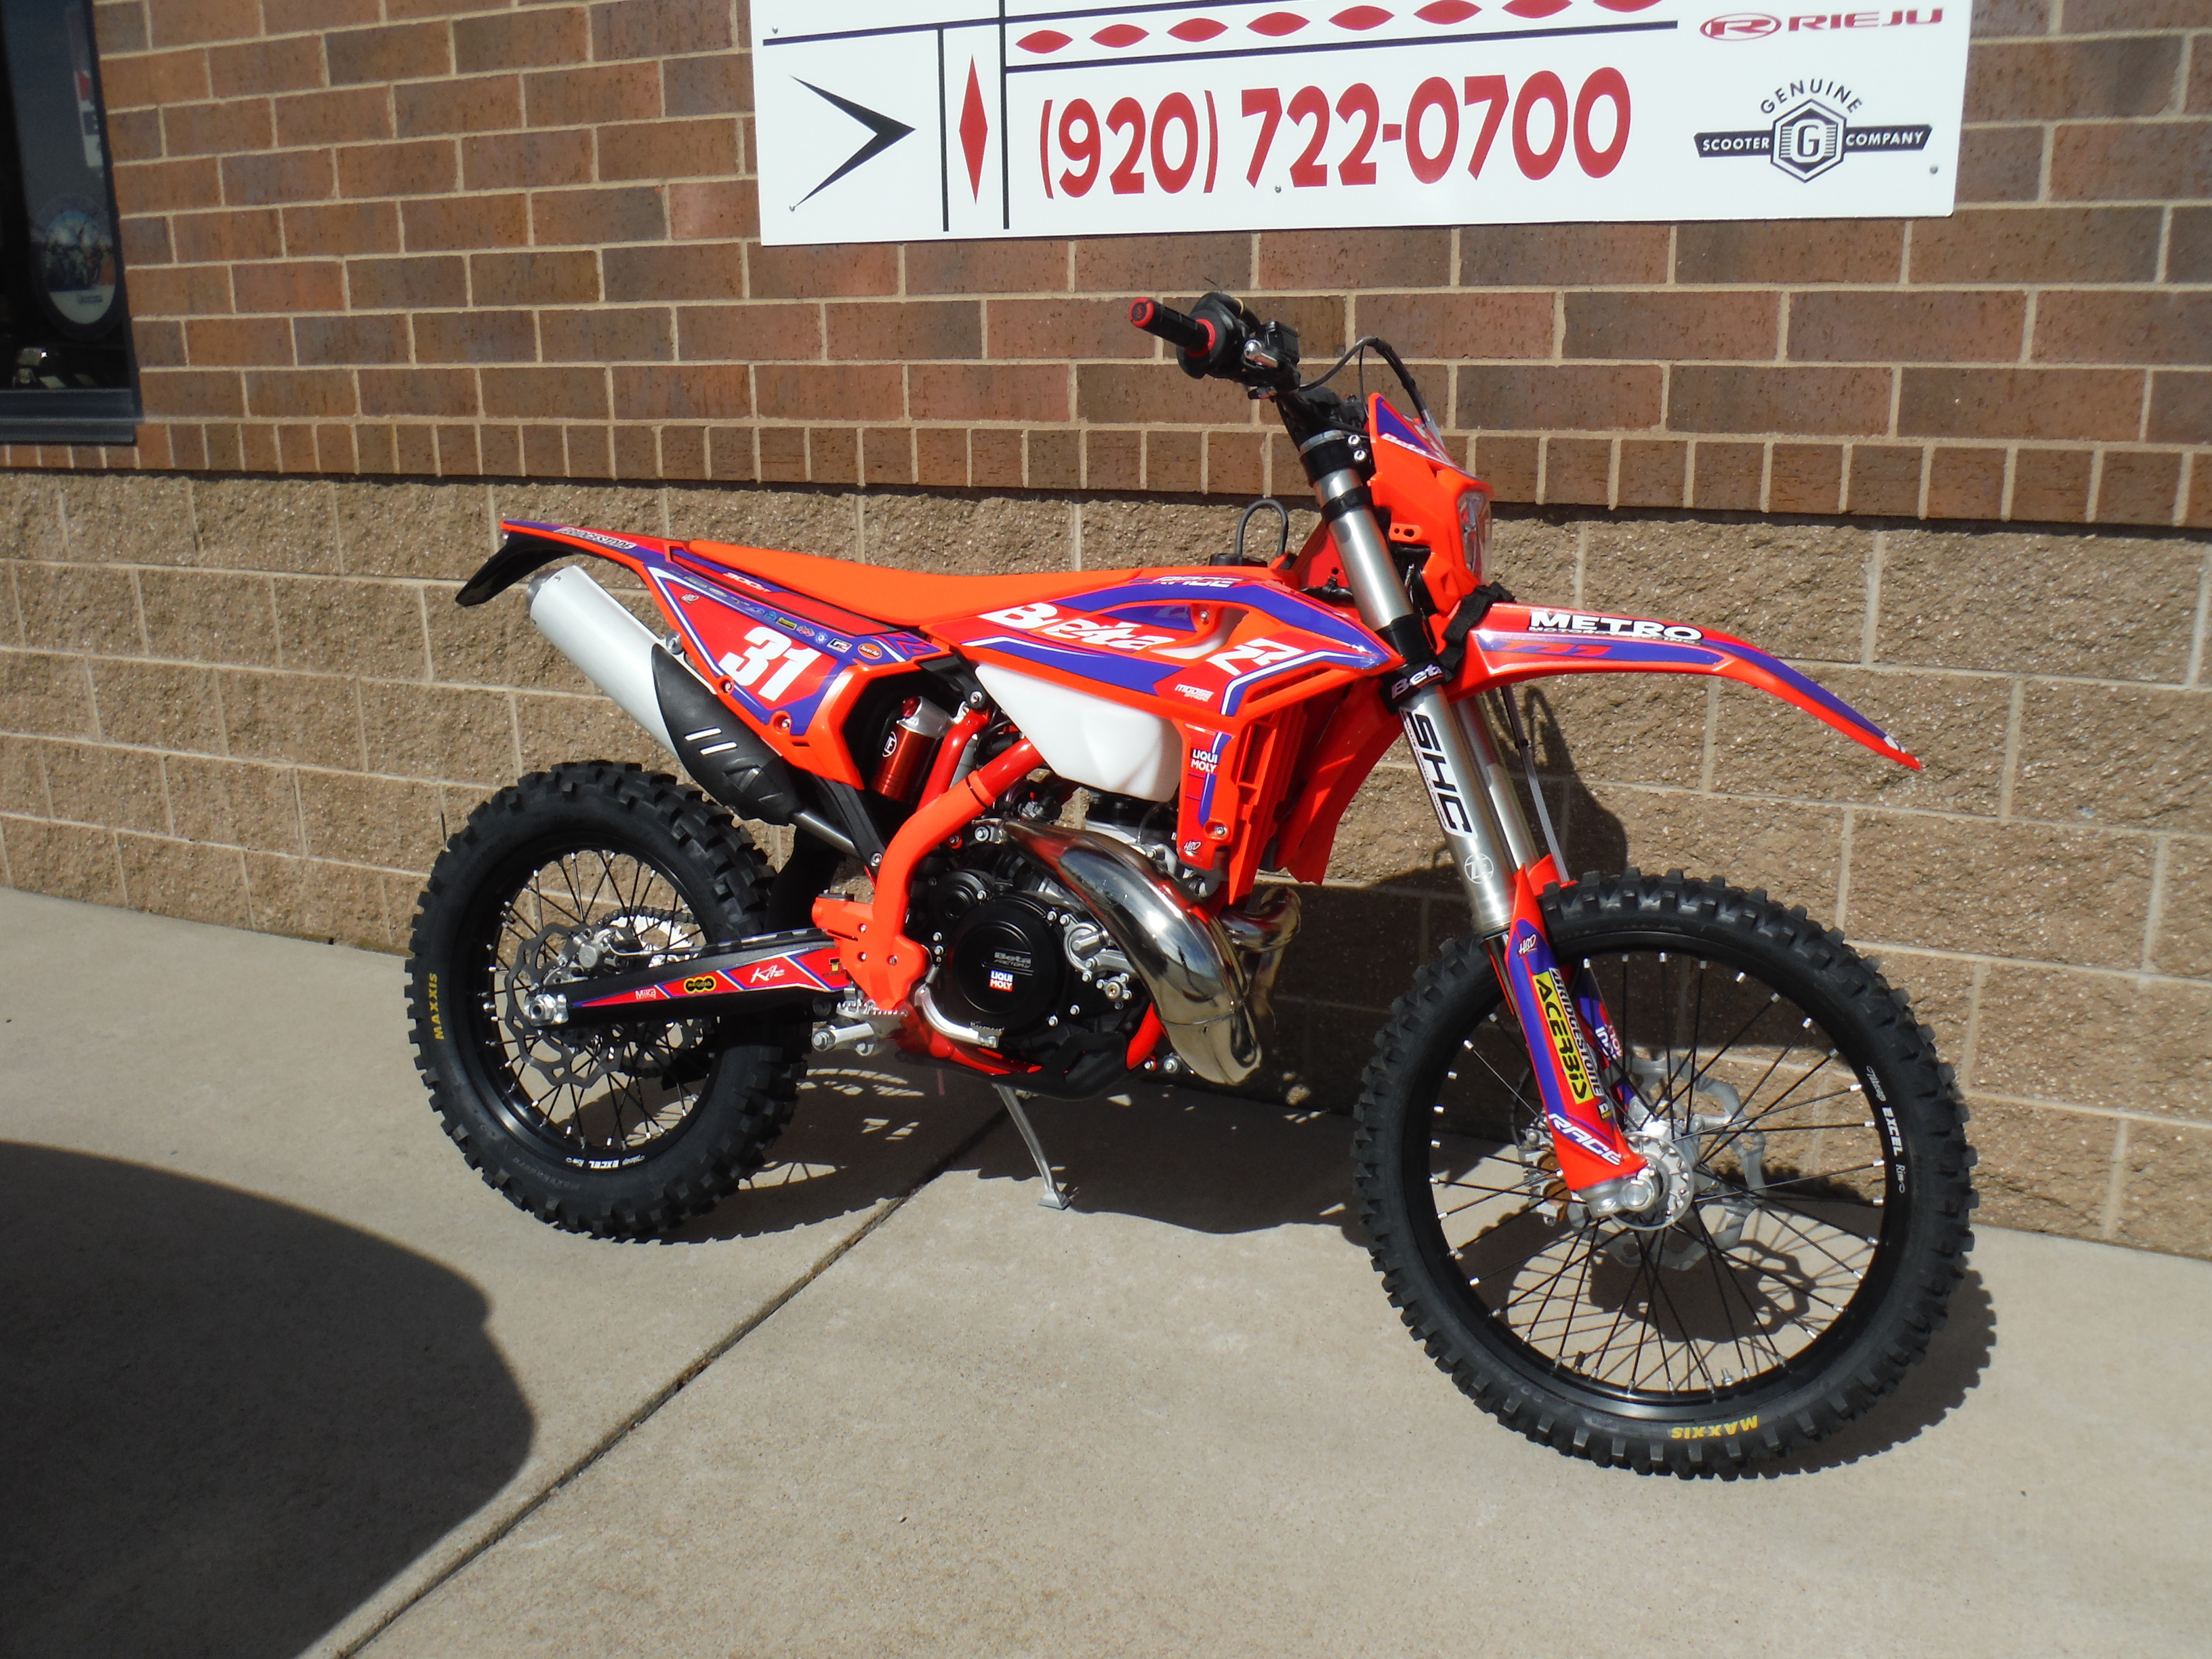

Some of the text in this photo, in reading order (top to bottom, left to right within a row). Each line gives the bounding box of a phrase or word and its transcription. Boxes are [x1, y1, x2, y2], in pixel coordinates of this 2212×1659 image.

[1788, 8, 1943, 31] RIEJU
[1760, 78, 1864, 115] GENUINE
[1040, 66, 1631, 199] (920) 722-0700
[1702, 124, 1925, 157] SCOOTER G COMPANY
[977, 602, 1176, 651] Beta
[1530, 610, 1702, 640] METRO
[859, 645, 872, 653] Twin
[718, 626, 822, 701] 31
[1174, 684, 1214, 698] MOOSE
[1190, 758, 1217, 773] MOLY
[1191, 749, 1218, 764] LIQUI
[1408, 712, 1473, 834] SHC
[994, 951, 1031, 964] Beta
[750, 964, 785, 983] Kite
[990, 979, 1013, 990] MOLY
[991, 970, 1013, 982] LIQUI
[428, 972, 445, 1040] MAXXIS
[635, 988, 657, 1000] Mika
[1551, 968, 1604, 1096] BRIDGESTONE
[1548, 1113, 1622, 1166] RACE
[1882, 1107, 1904, 1156] EXCEL
[588, 1159, 619, 1169] EXCEL
[1671, 1415, 1759, 1439] MAXXIS
